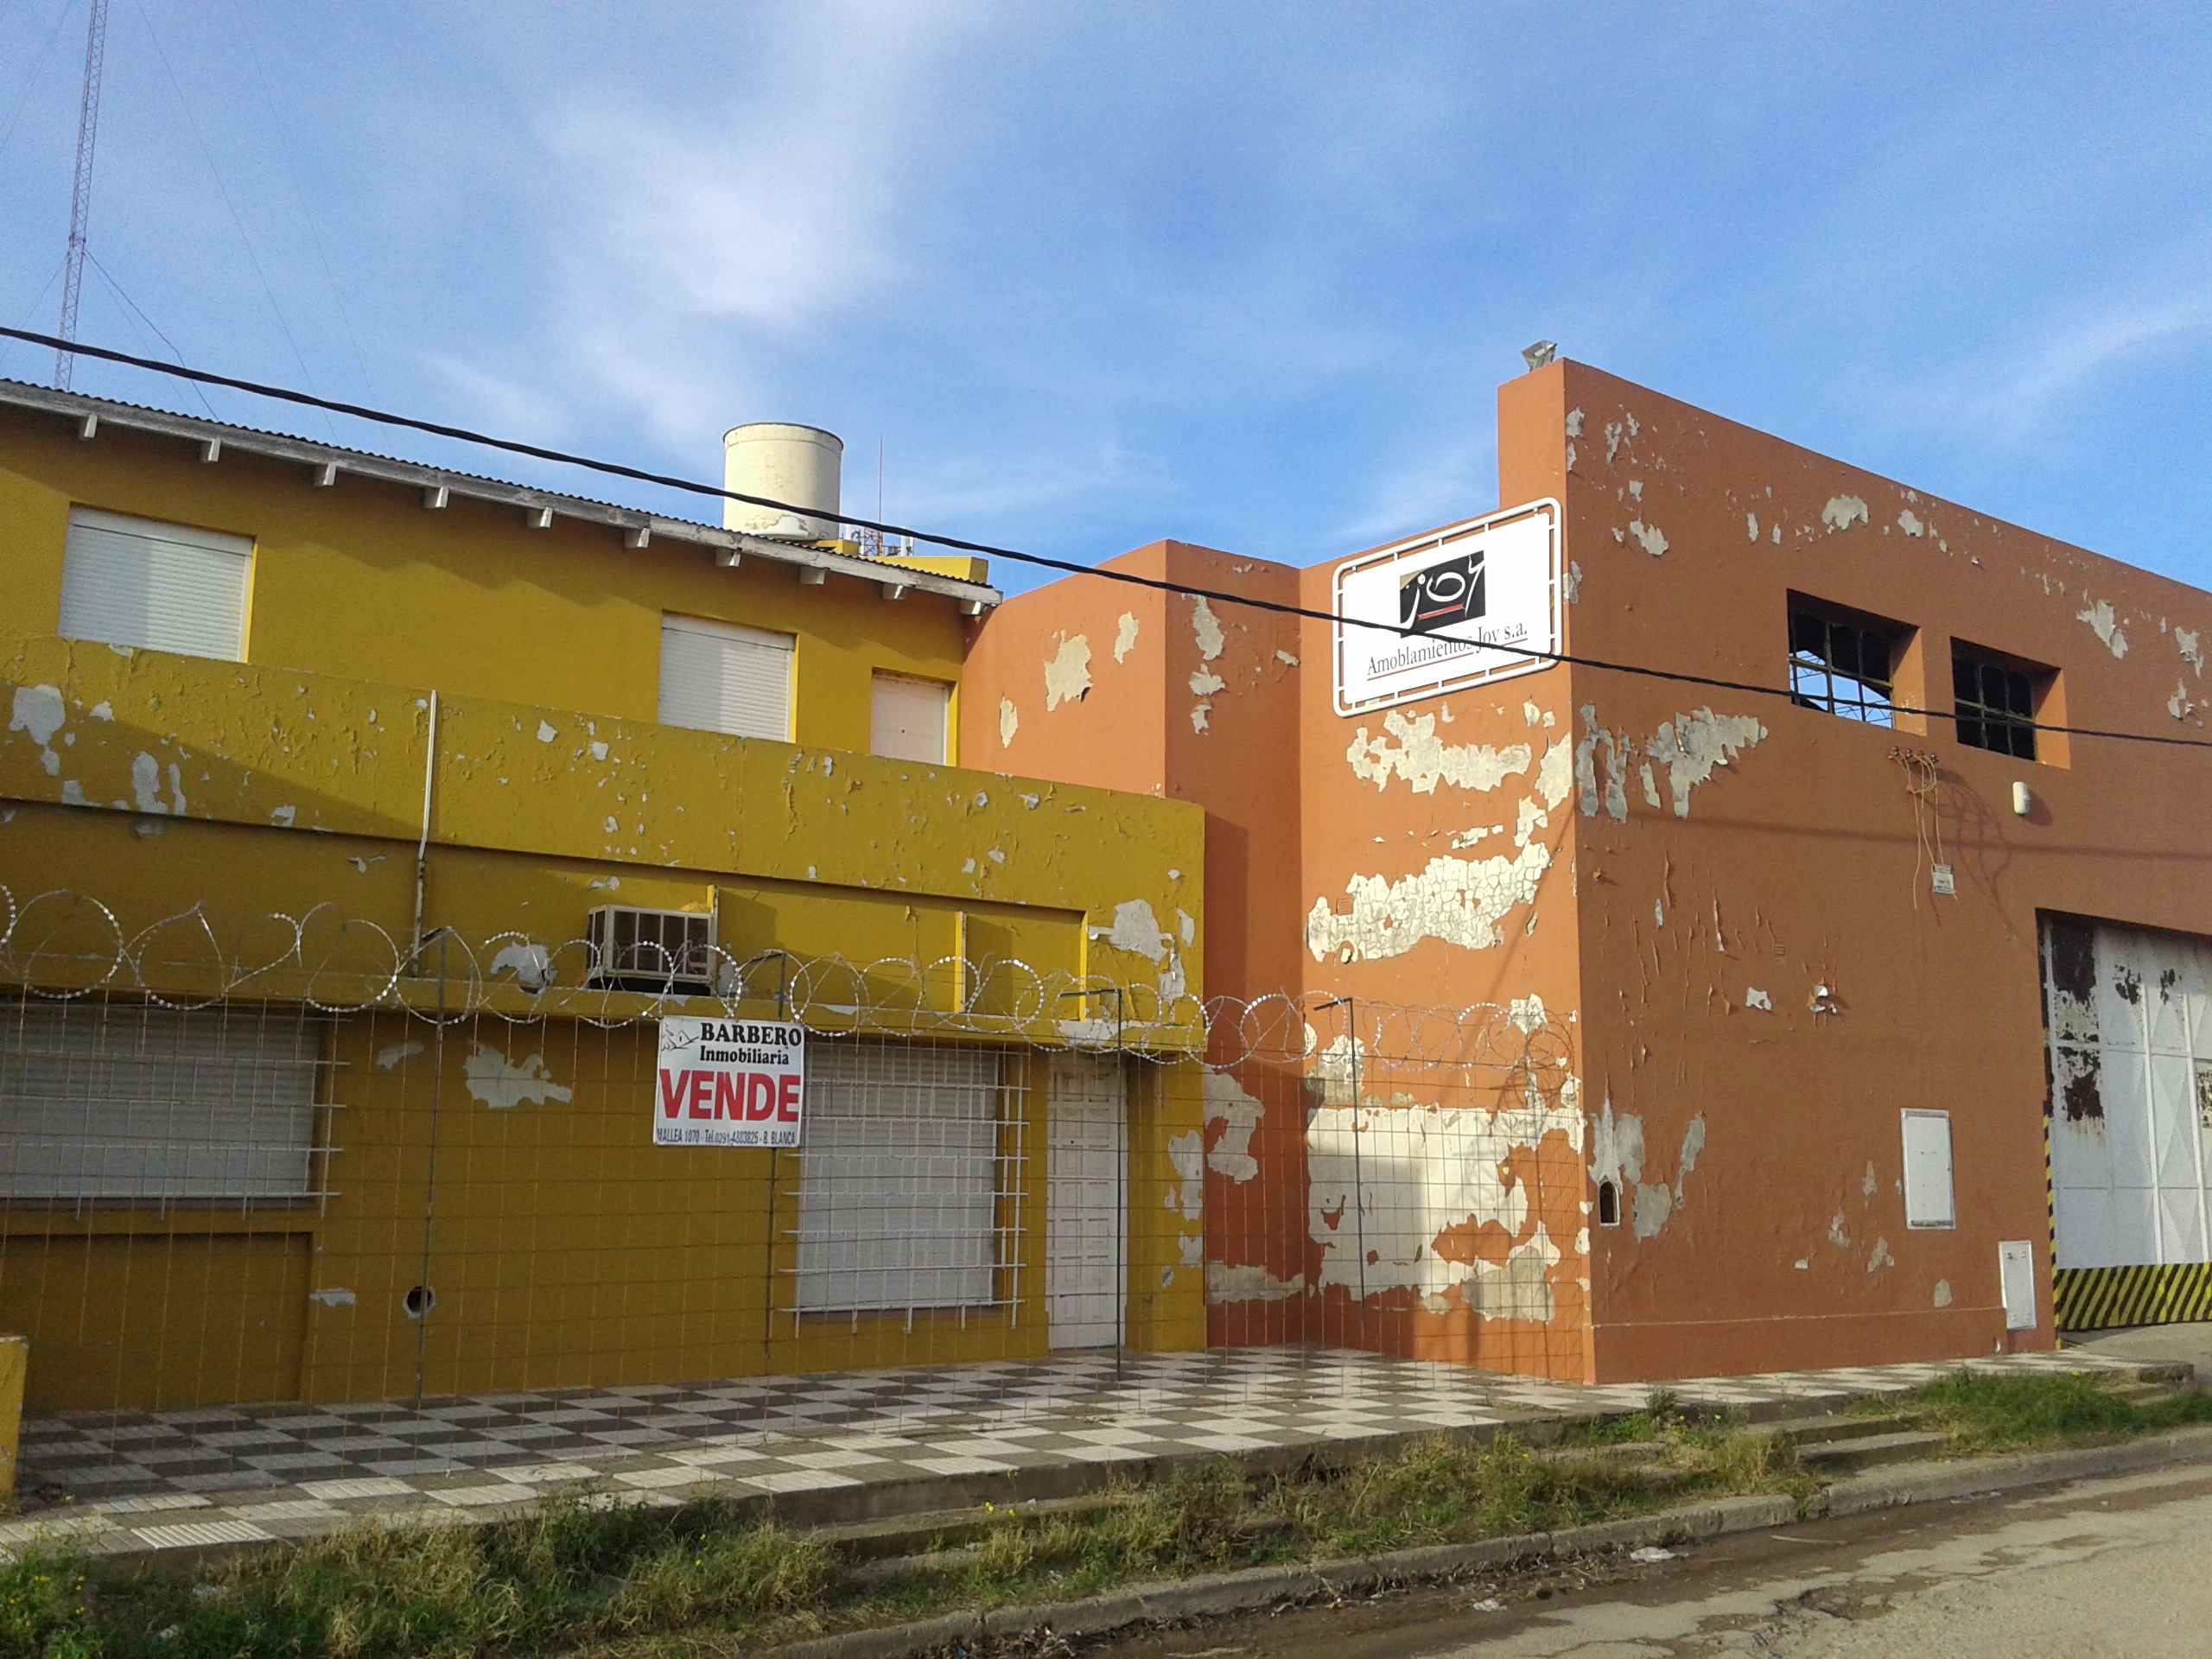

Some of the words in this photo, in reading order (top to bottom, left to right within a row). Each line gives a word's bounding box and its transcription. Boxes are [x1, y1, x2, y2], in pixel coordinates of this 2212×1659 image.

[1367, 635, 1473, 676] Amoblamientos
[1503, 622, 1528, 640] s.a.
[700, 1022, 802, 1046] BARBERO
[699, 1045, 789, 1065] Inmobiliaria
[658, 1068, 801, 1122] VENDE
[657, 1128, 683, 1143] MALLEA
[684, 1128, 700, 1144] 1070
[771, 1130, 796, 1145] BLANCA
